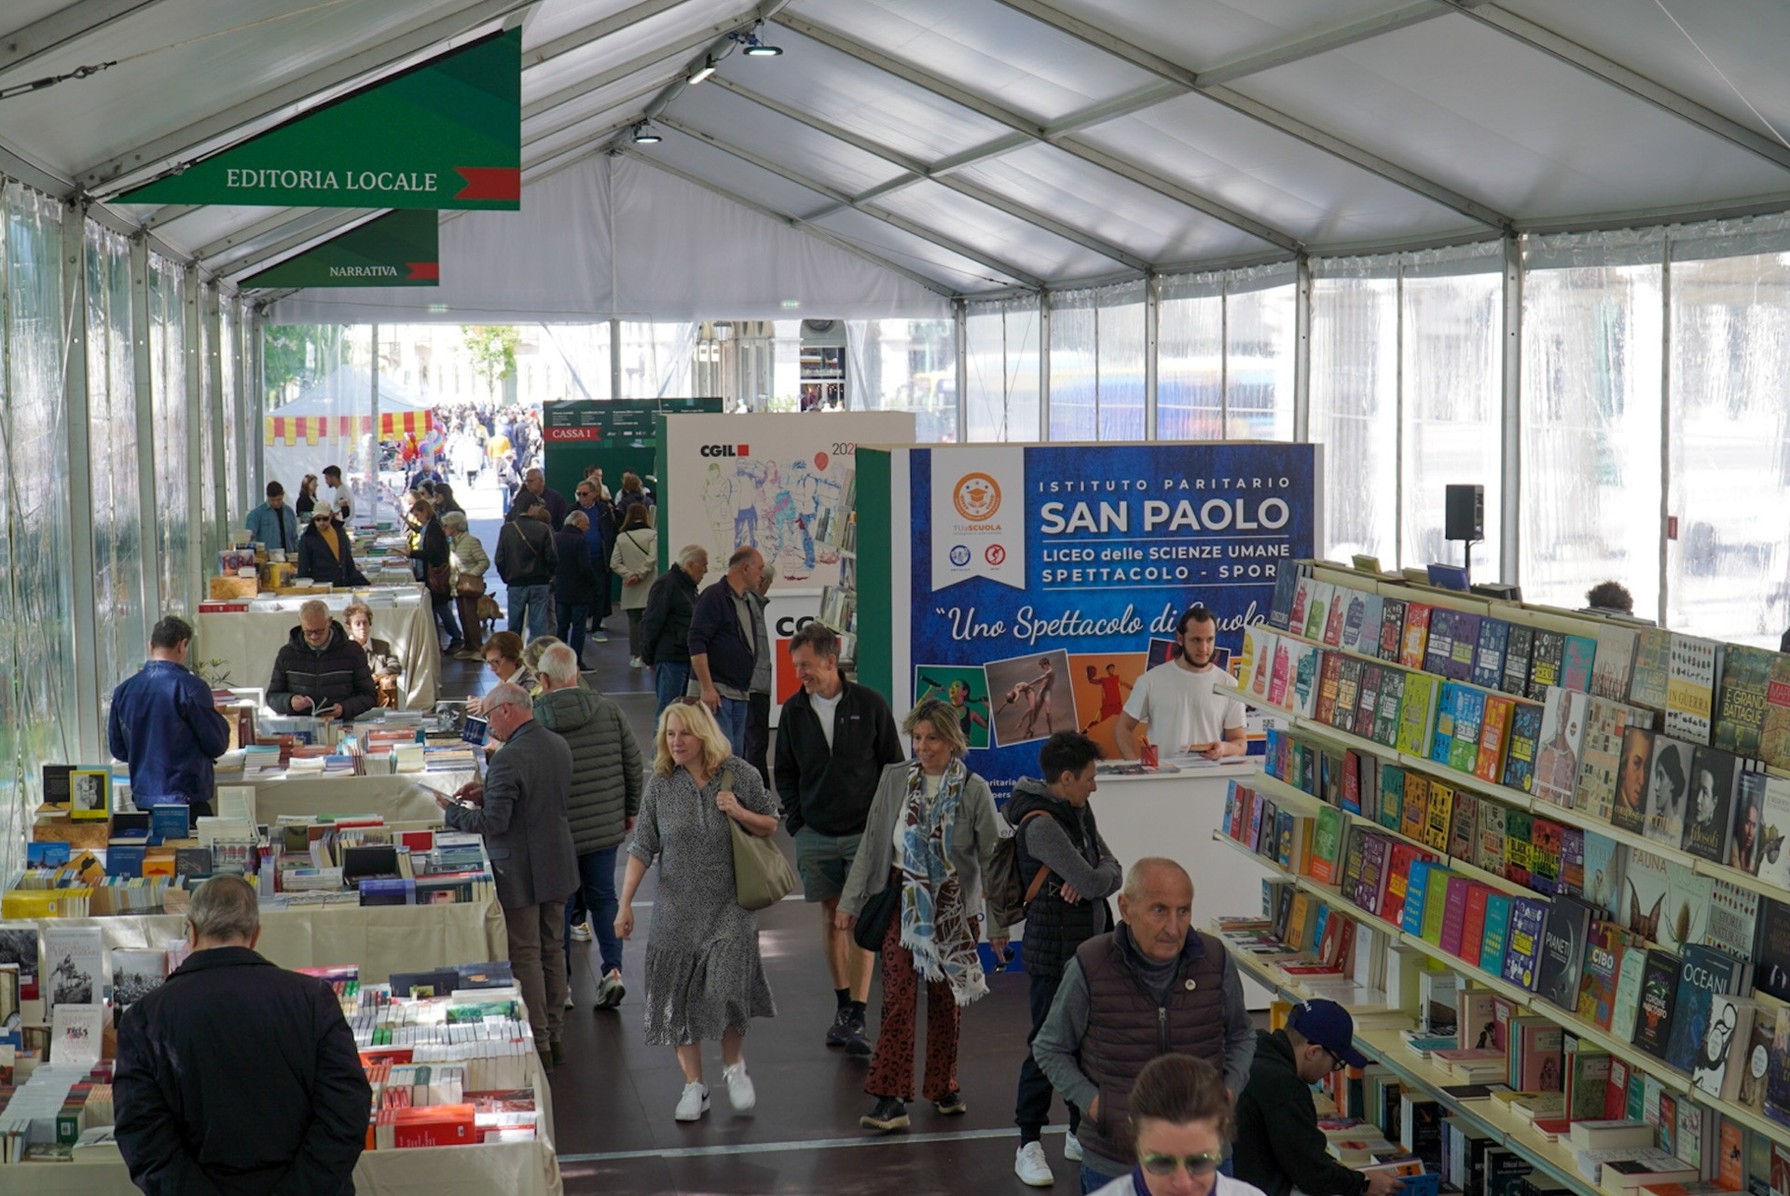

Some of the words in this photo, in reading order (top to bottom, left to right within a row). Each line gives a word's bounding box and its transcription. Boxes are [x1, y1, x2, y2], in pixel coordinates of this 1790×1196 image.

[226, 168, 339, 190] EDITORIA
[346, 171, 437, 192] LOCALE
[329, 265, 398, 278] NARRATIVA
[552, 429, 585, 439] CASSA
[586, 429, 591, 438] 1
[700, 444, 736, 458] CGIL
[832, 442, 857, 456] 202
[1039, 478, 1148, 492] ISTITUTO
[1164, 476, 1291, 490] PARITARIO
[1040, 500, 1129, 534] SAN
[1143, 497, 1290, 532] PAOLO
[1043, 548, 1096, 562] LICEO
[1101, 546, 1143, 561] delle
[1149, 545, 1222, 560] SCIENZE
[1228, 543, 1290, 558] UMANE
[1042, 566, 1189, 583] SPETTACOLO
[1219, 564, 1276, 579] SPOR
[1013, 603, 1144, 645] Spettacolo
[1150, 602, 1178, 633] di
[1631, 848, 1667, 875] FAUNA
[1592, 948, 1614, 969] CIBO
[1683, 962, 1728, 994] OCEANI
